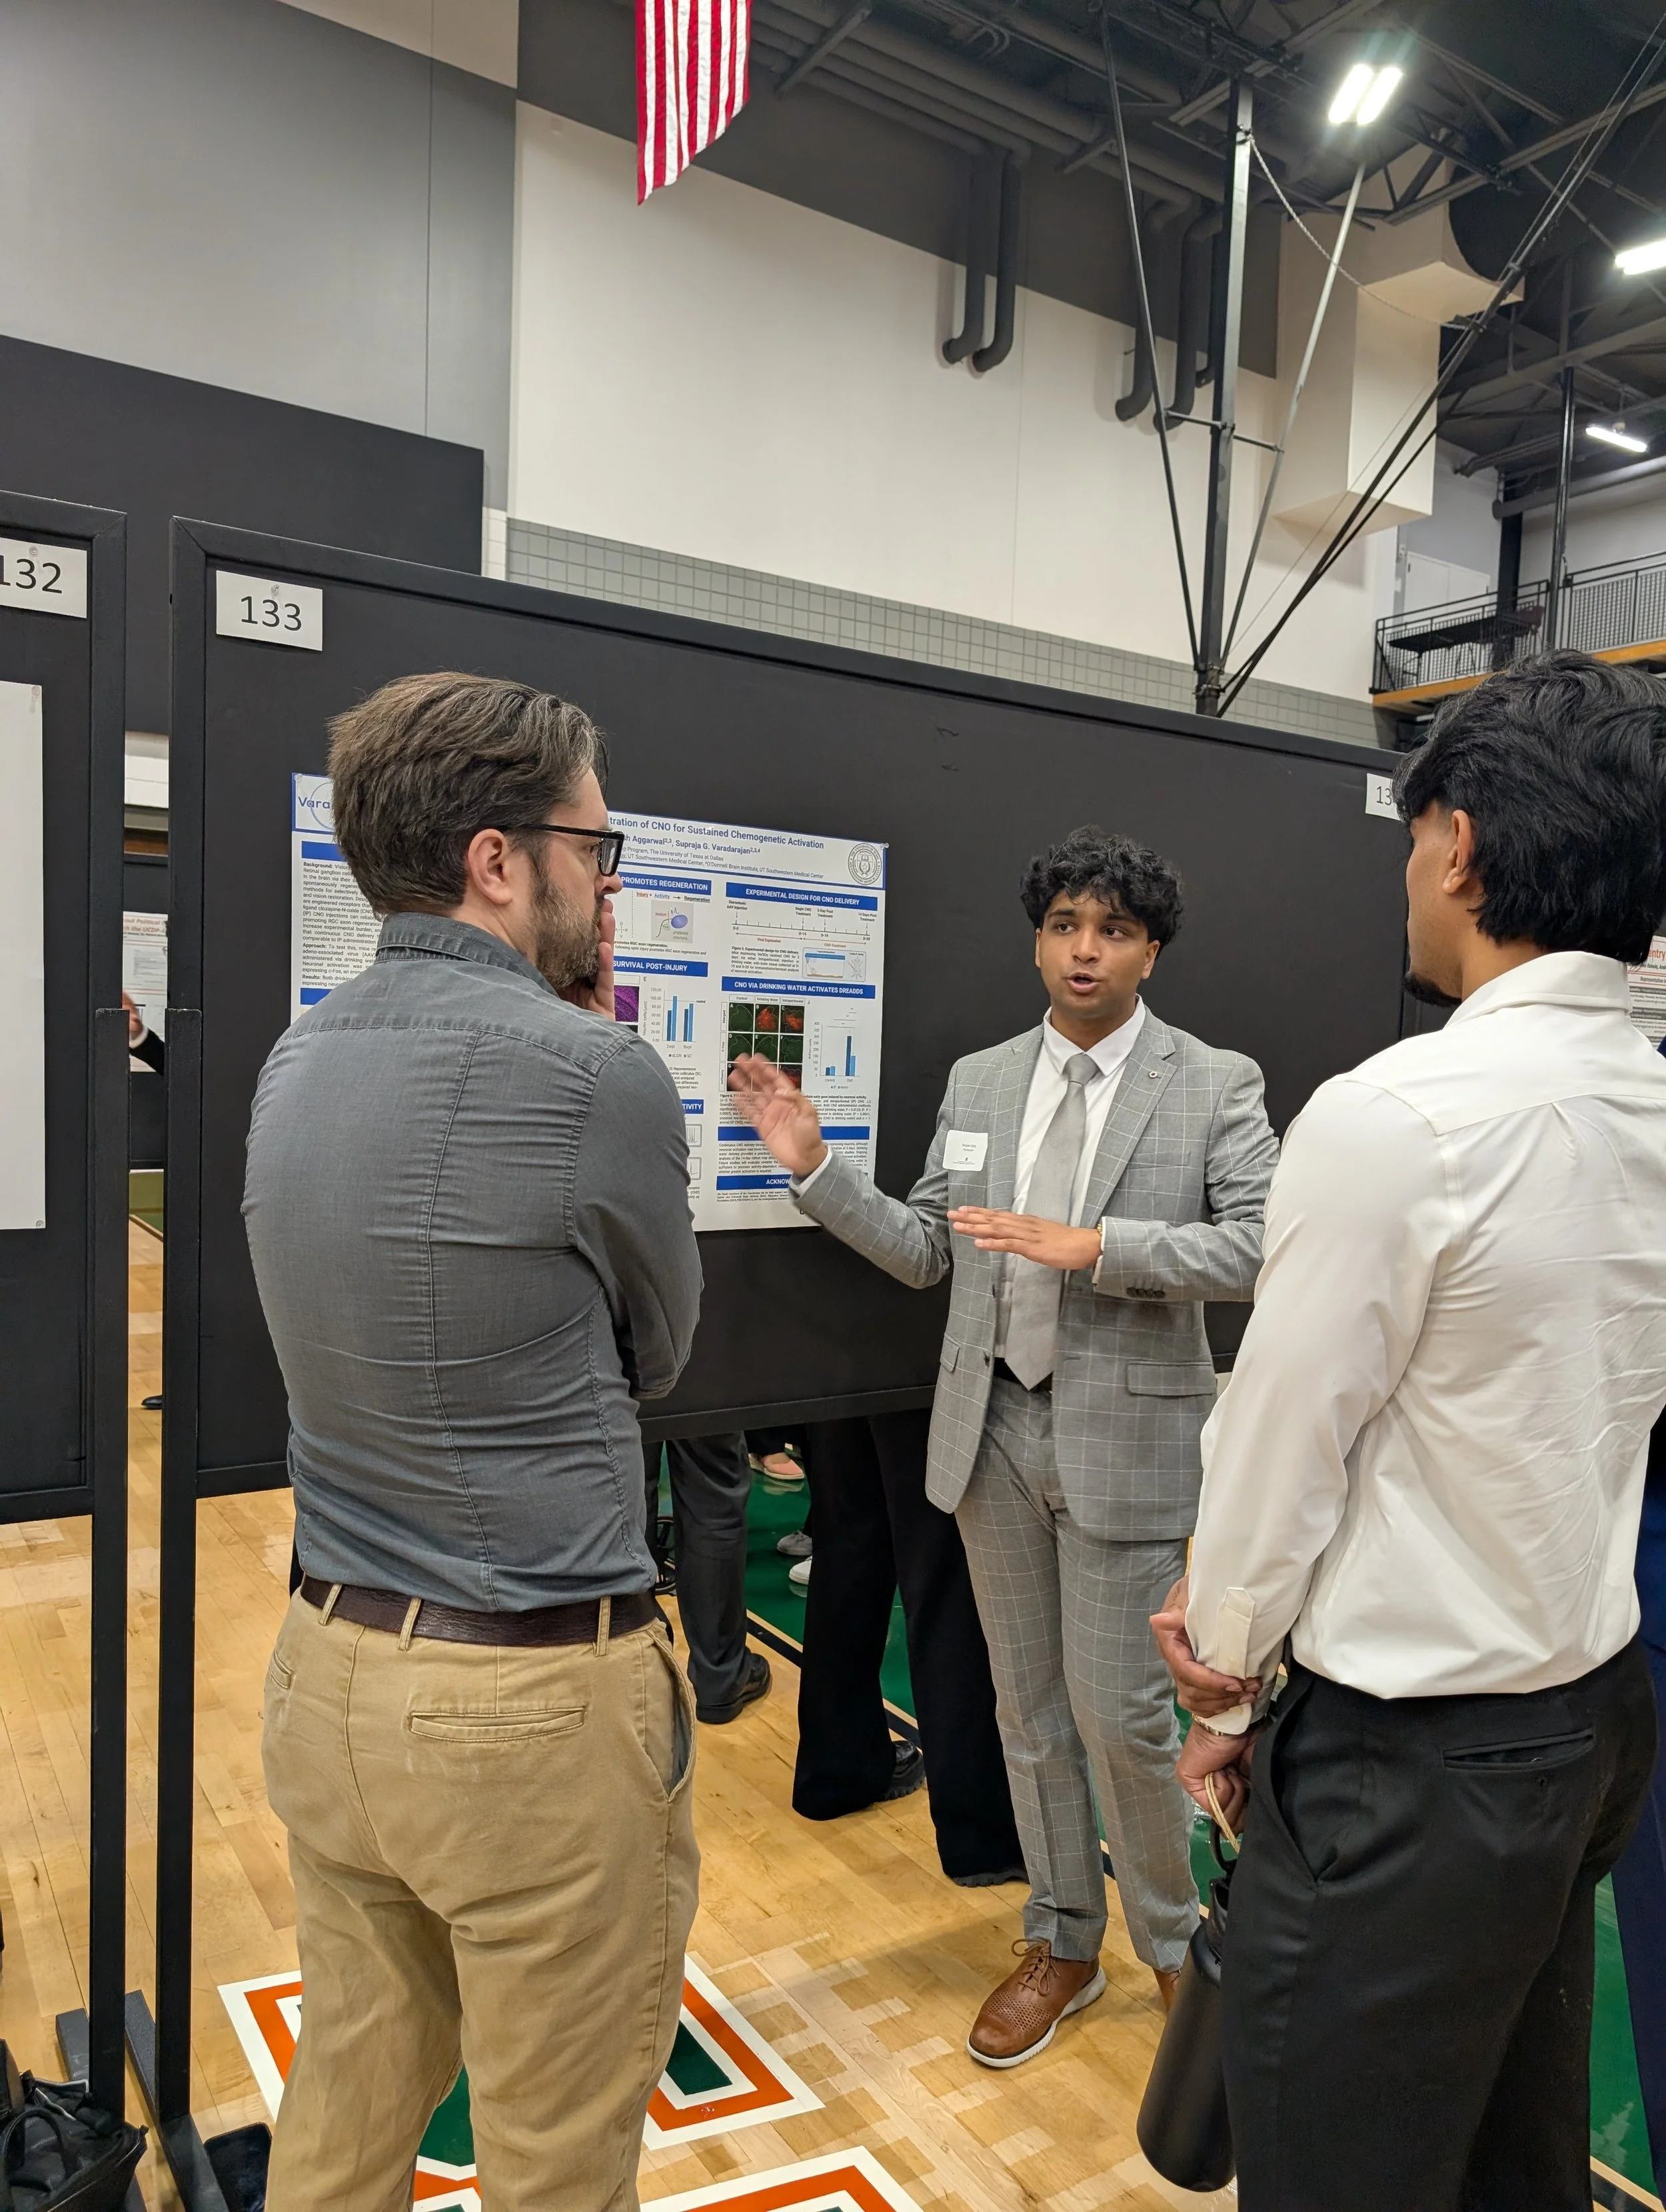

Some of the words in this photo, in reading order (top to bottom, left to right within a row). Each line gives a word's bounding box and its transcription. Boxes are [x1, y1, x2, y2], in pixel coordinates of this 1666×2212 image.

[0, 556, 63, 594] 132
[241, 596, 302, 631] 133
[299, 796, 330, 809] Vara
[608, 817, 638, 828] tration
[652, 822, 670, 831] CNO
[673, 824, 685, 832] for
[688, 826, 728, 837] Sustained
[731, 830, 786, 843] Chemogenetic
[788, 837, 824, 849] Activation
[676, 840, 700, 849] Supraja
[622, 877, 657, 885] PROMOTES
[659, 881, 708, 890] REGENERATION
[746, 889, 787, 899] EXPERIMENTAL
[646, 963, 688, 971] POST-INJURY
